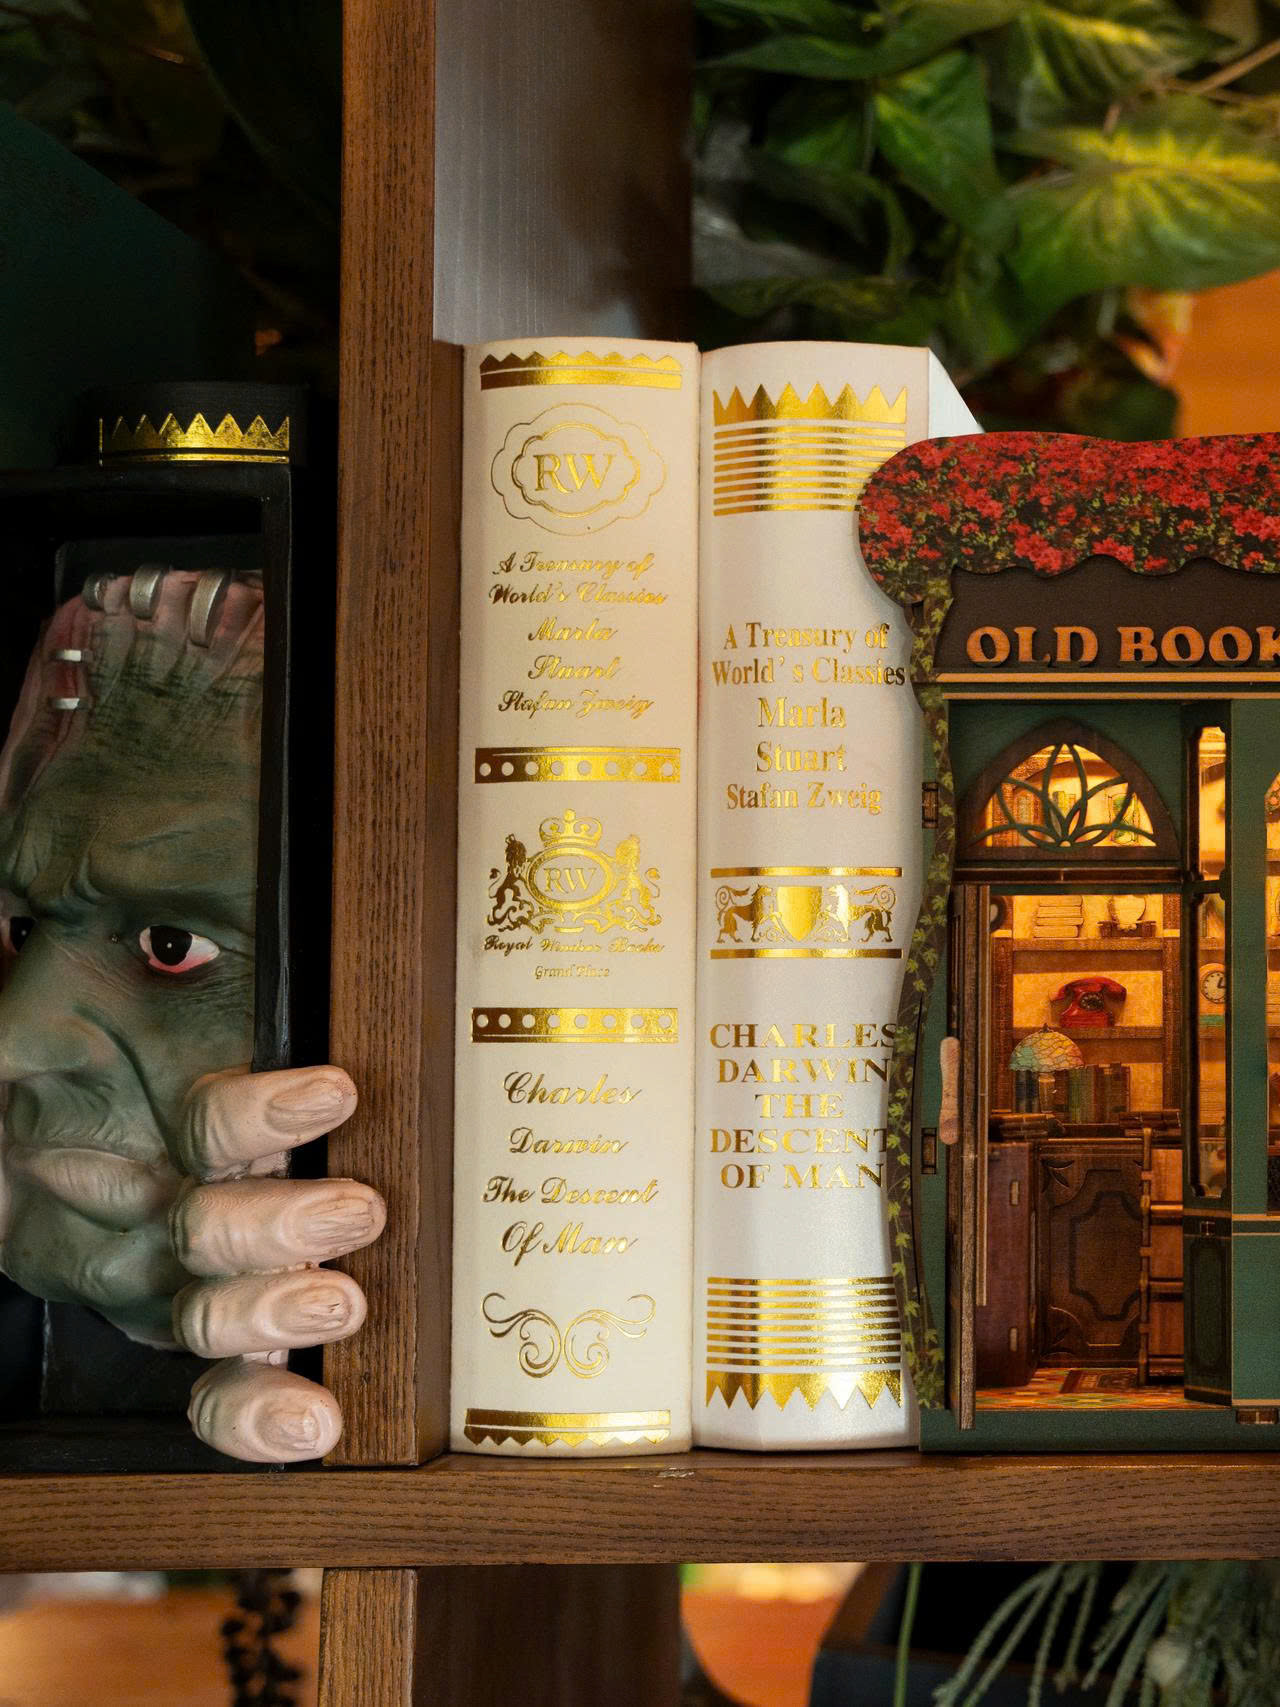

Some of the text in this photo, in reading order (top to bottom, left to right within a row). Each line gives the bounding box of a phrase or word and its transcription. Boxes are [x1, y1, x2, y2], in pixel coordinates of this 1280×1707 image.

[533, 453, 616, 494] RW
[492, 551, 517, 575] A
[627, 552, 655, 580] of
[528, 616, 618, 641] Marla
[724, 622, 890, 653] A Treasury of
[965, 625, 1099, 666] OLD
[528, 655, 622, 680] Stuart
[575, 689, 655, 719] Zweig
[757, 697, 847, 729] Marla
[756, 741, 847, 772] Stuart
[727, 782, 883, 815] Stafan Zweig
[543, 867, 597, 894] RW
[709, 1023, 897, 1048] CHARLES
[717, 1058, 891, 1083] DARWIN
[503, 1071, 642, 1105] Charles
[754, 1093, 844, 1118] THE
[508, 1127, 629, 1154] Darwin
[709, 1128, 888, 1153] DESCENT
[483, 1176, 659, 1204] The Descent
[720, 1163, 884, 1189] OF MAN
[501, 1221, 639, 1266] Of Man
